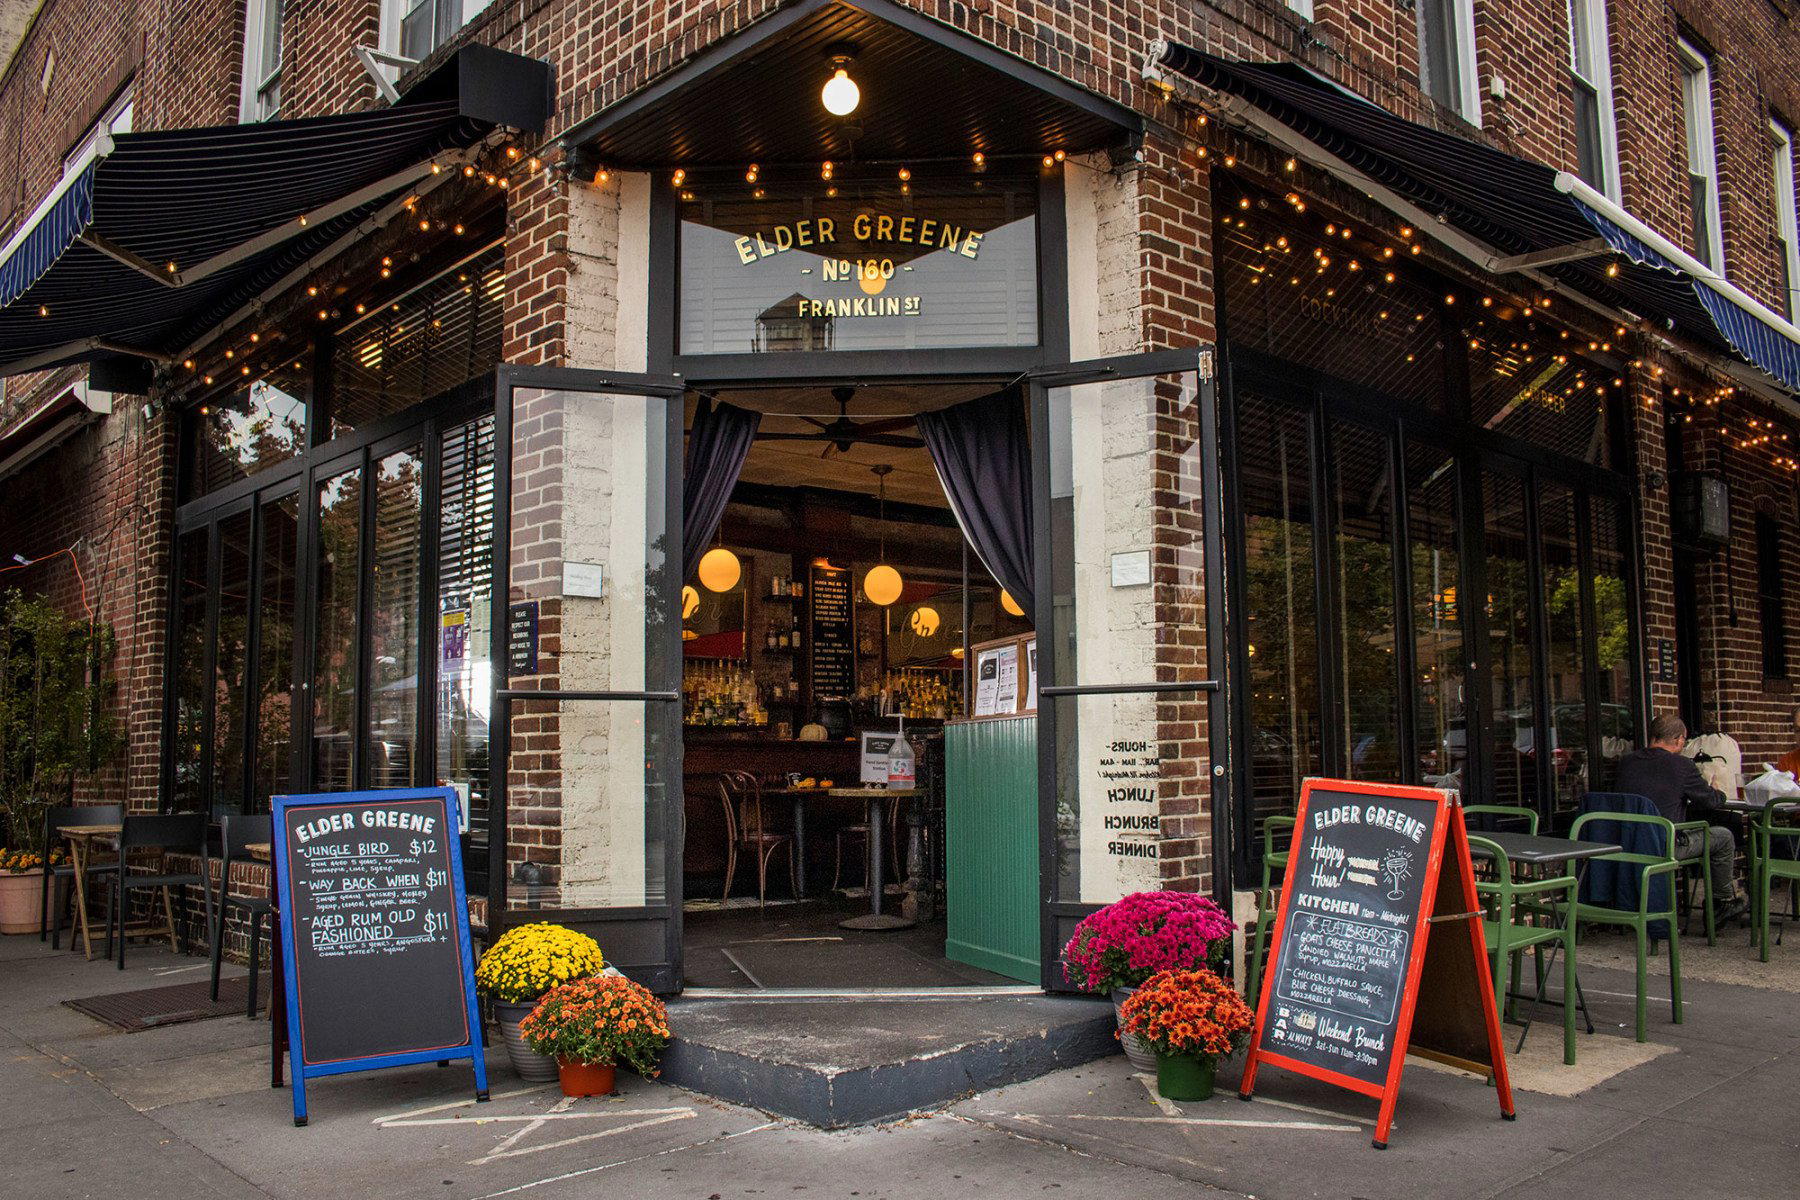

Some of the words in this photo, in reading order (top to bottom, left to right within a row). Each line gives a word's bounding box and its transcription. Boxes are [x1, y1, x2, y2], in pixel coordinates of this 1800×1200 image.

[734, 217, 836, 265] ELDER
[853, 213, 985, 260] GREENE
[856, 258, 895, 281] 160
[798, 297, 900, 318] FRANKLIN
[904, 296, 921, 316] ST
[295, 813, 355, 844] ELDER
[361, 810, 436, 835] GREENE
[1314, 805, 1361, 830] ELDER
[1365, 805, 1427, 844] GREENE
[304, 844, 351, 860] JUNGLE
[358, 842, 389, 856] BIRD
[409, 839, 438, 857] $12
[1310, 836, 1345, 868] Happy
[309, 880, 334, 892] WAY
[342, 877, 377, 891] BACK
[386, 874, 420, 887] WHEN
[425, 868, 447, 891] $11
[1310, 862, 1346, 888] Hour!
[1297, 893, 1360, 916] KITCHEN
[311, 914, 344, 931] AGED
[350, 912, 382, 926] RUM
[388, 909, 415, 924] OLD
[423, 909, 448, 937] $11
[311, 925, 394, 944] FASHIONED
[1320, 919, 1388, 945] FLATBREADS
[1298, 944, 1329, 958] CANDIED
[1368, 959, 1390, 968] MAPLE
[1291, 979, 1308, 991] BLUE
[1310, 983, 1335, 996] CHEESE
[1327, 975, 1358, 988] BUFFALO
[1274, 1007, 1290, 1041] BAR
[1317, 1017, 1353, 1043] Weekend
[1355, 1026, 1385, 1051] Brunch
[1287, 1031, 1313, 1046] ALWAYS
